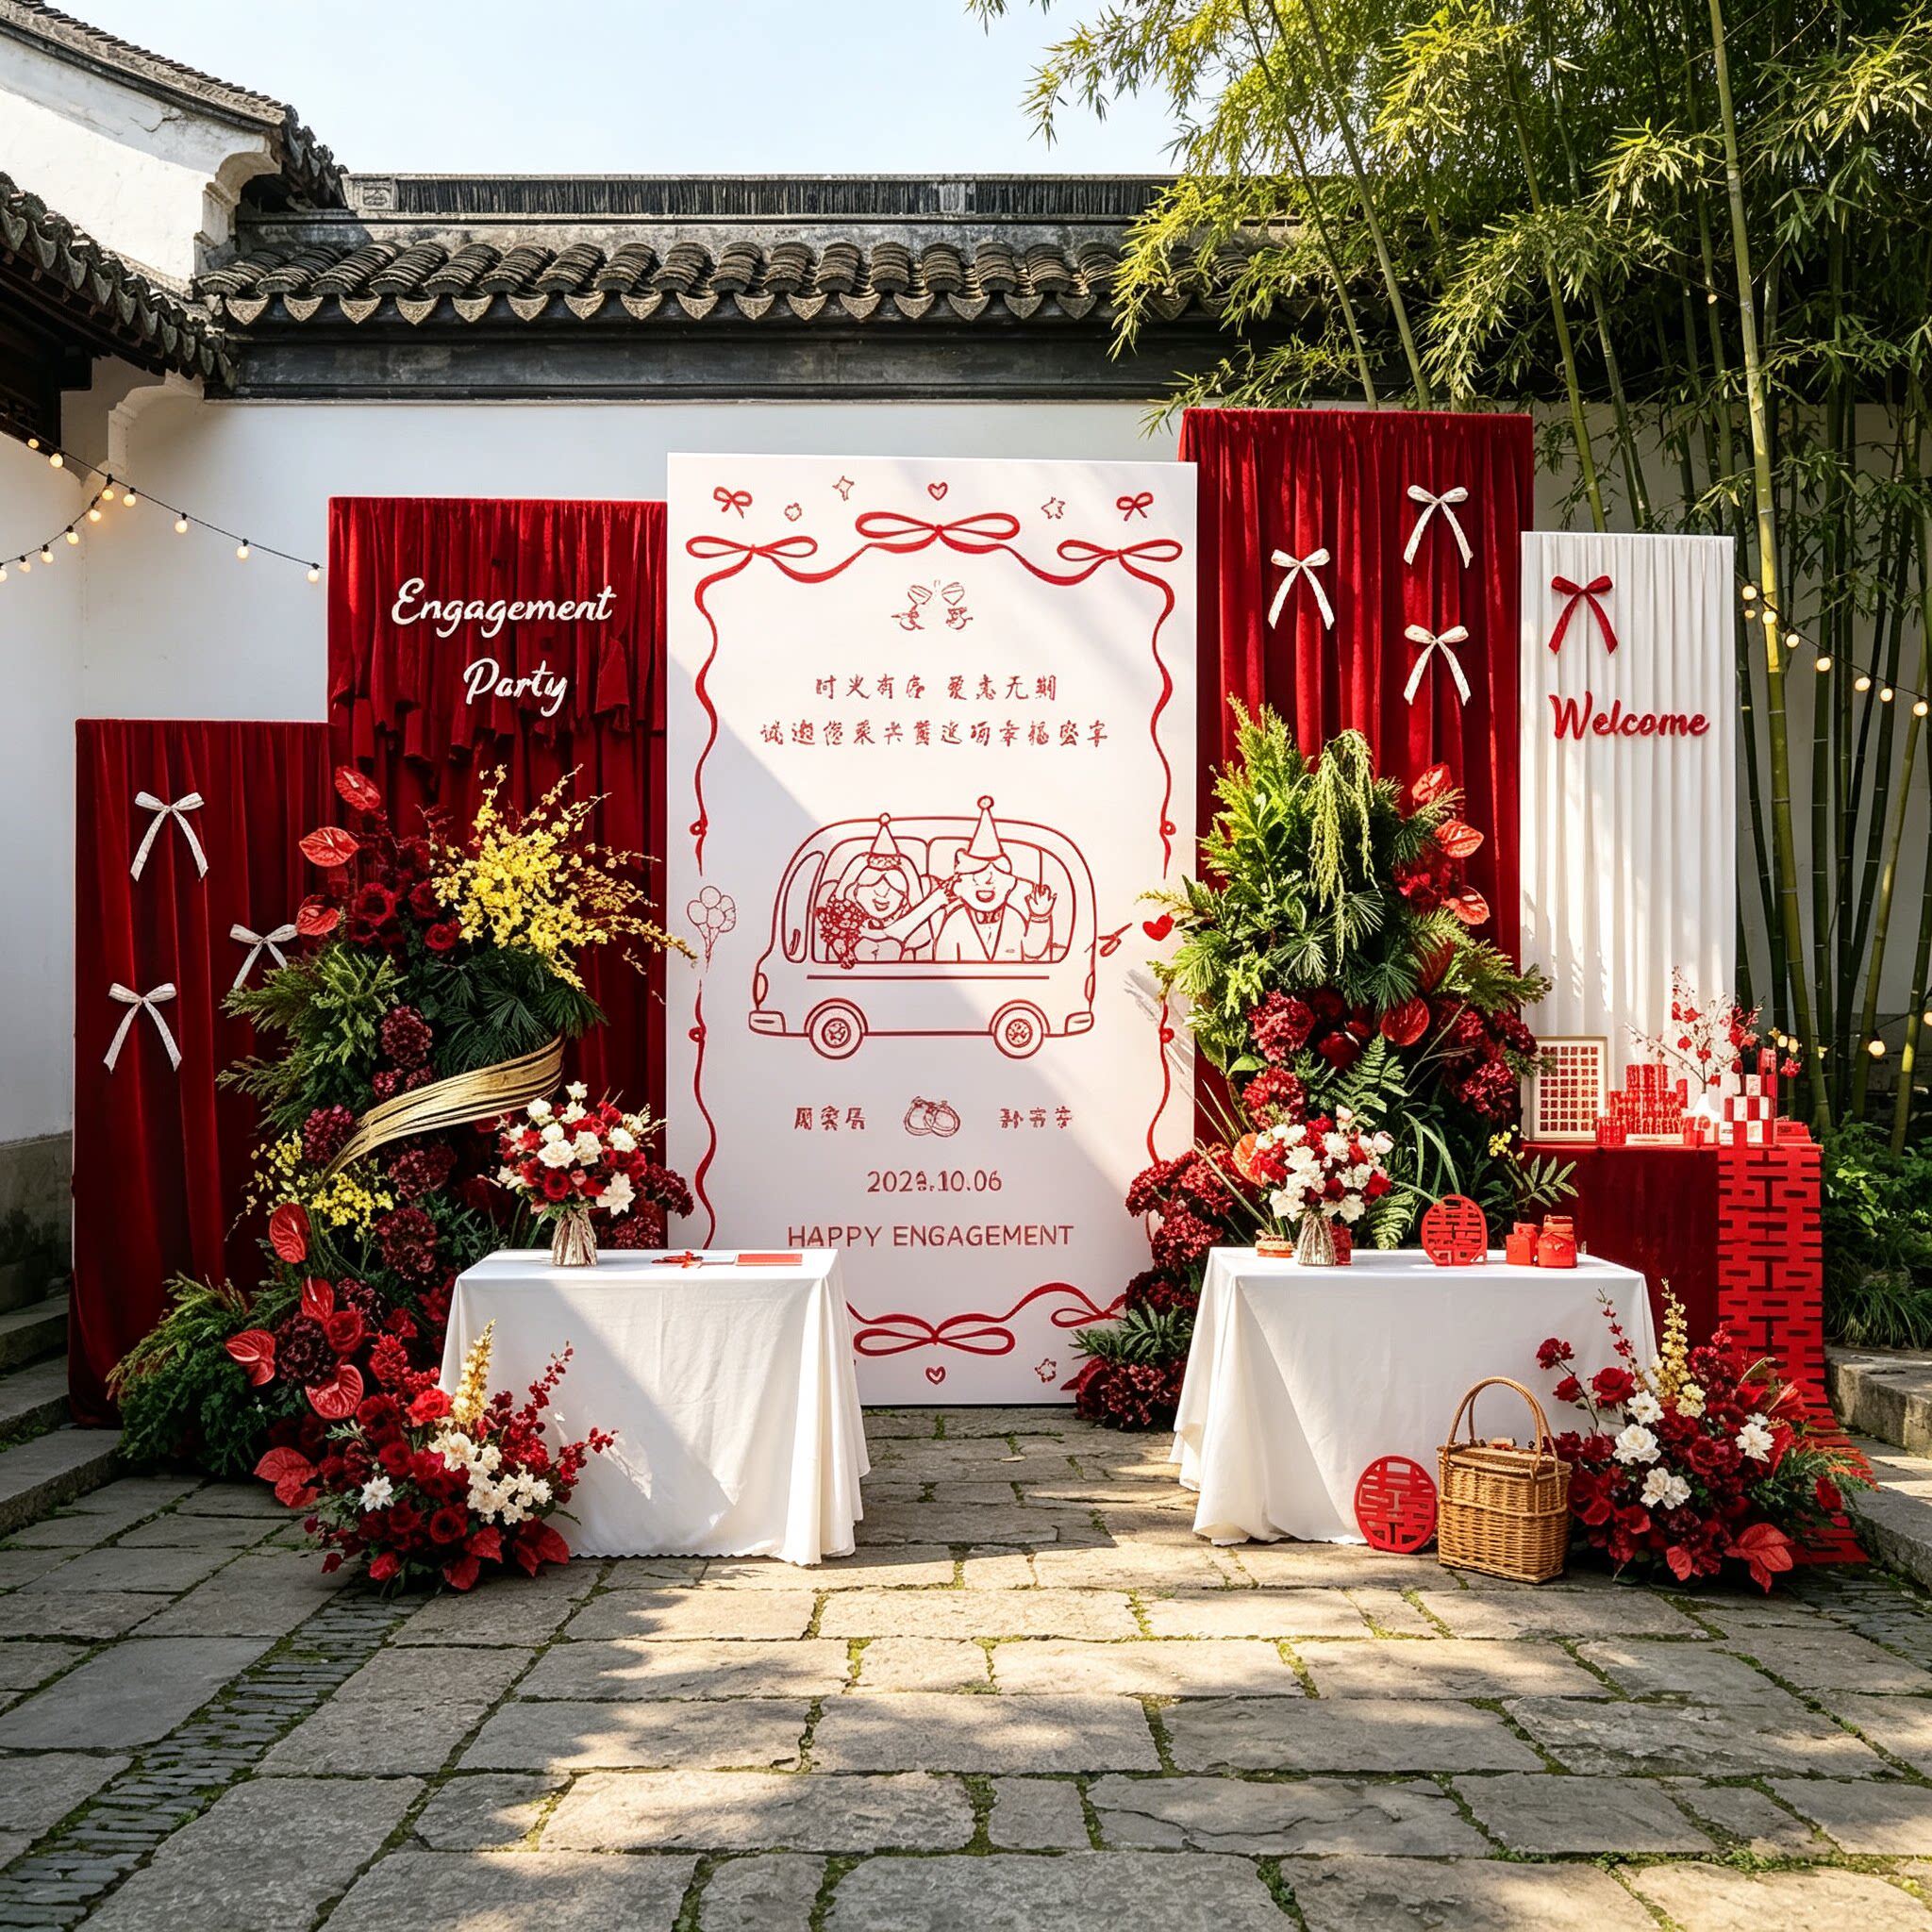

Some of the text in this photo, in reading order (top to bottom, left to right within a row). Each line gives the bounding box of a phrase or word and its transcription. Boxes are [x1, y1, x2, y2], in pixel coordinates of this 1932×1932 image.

[391, 577, 617, 638] Engagement
[463, 658, 568, 717] Party
[1548, 691, 1709, 740] Welcome
[788, 1224, 1074, 1248] HAPPY ENGAGEMENT
